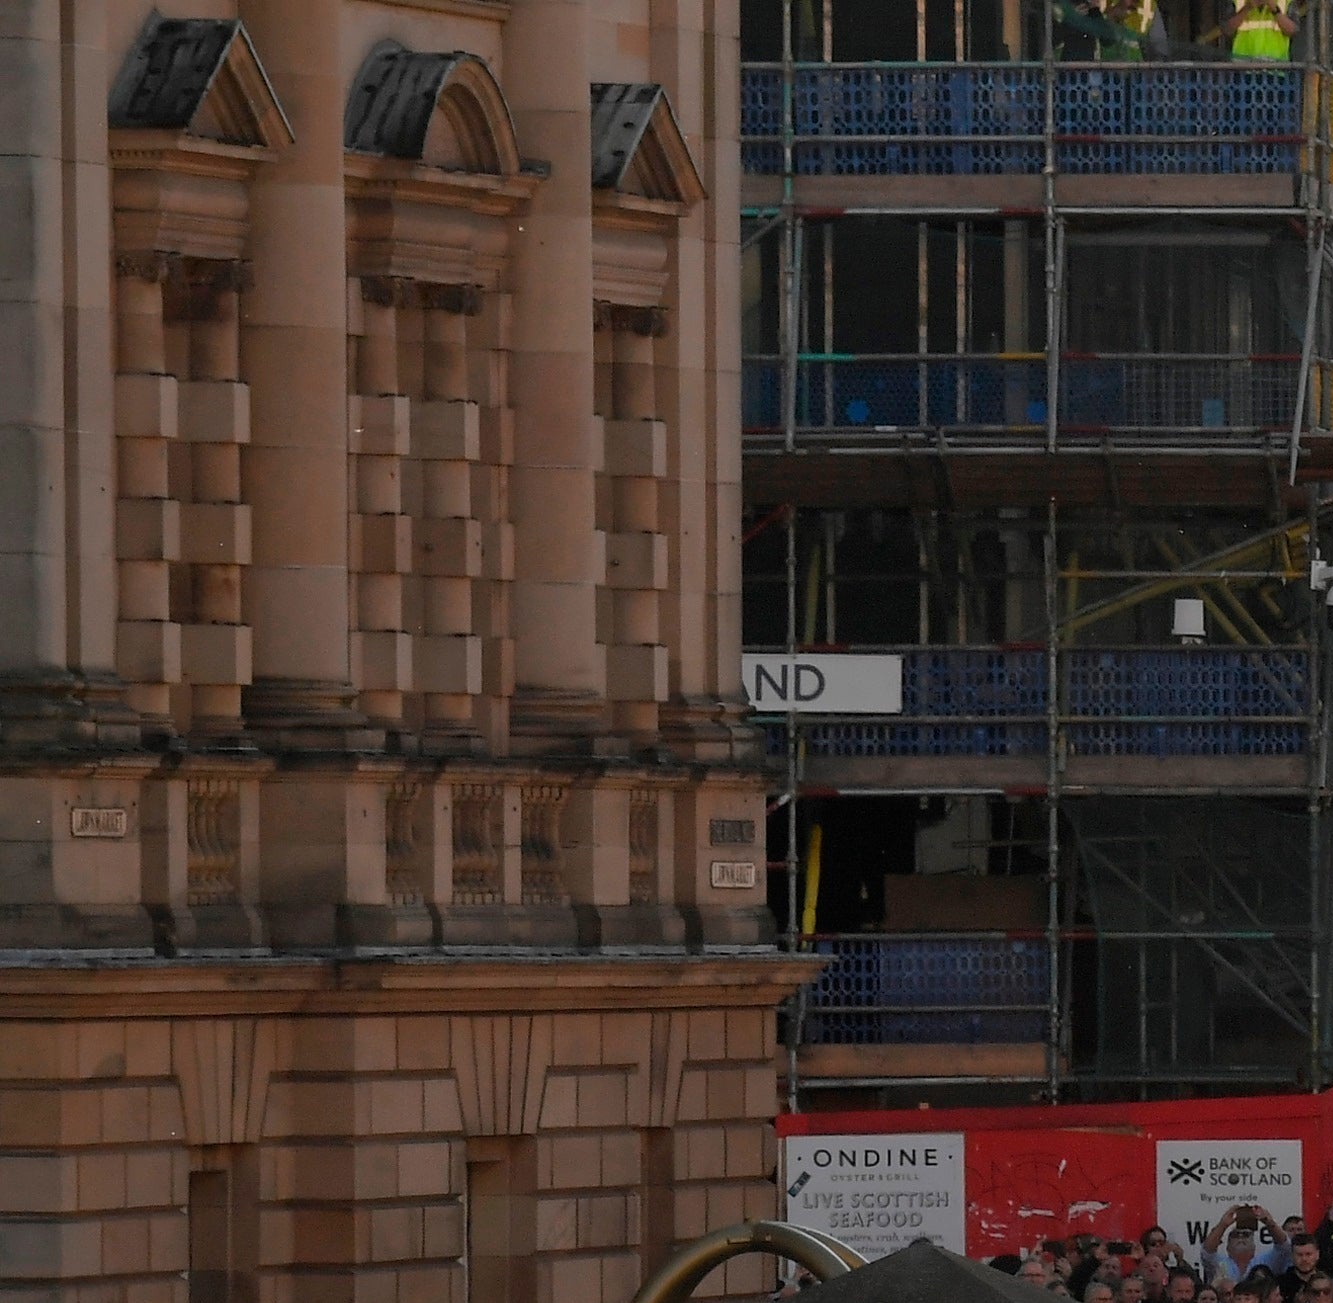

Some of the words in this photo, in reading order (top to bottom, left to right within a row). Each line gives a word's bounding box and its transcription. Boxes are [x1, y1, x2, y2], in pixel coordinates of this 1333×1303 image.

[748, 664, 825, 702] ND
[813, 1149, 939, 1168] ONDINE
[1209, 1158, 1251, 1170] BANK
[1256, 1157, 1277, 1170] OF
[831, 1173, 875, 1182] OYSTER
[885, 1173, 920, 1181] GRILL
[1210, 1173, 1292, 1186] SCOTLAND
[802, 1192, 844, 1210] LIVE
[851, 1190, 949, 1209] SCOTTISH
[1200, 1193, 1212, 1203] By
[1214, 1194, 1236, 1204] your
[1239, 1193, 1258, 1202] side
[829, 1212, 923, 1229] SEAFOOD
